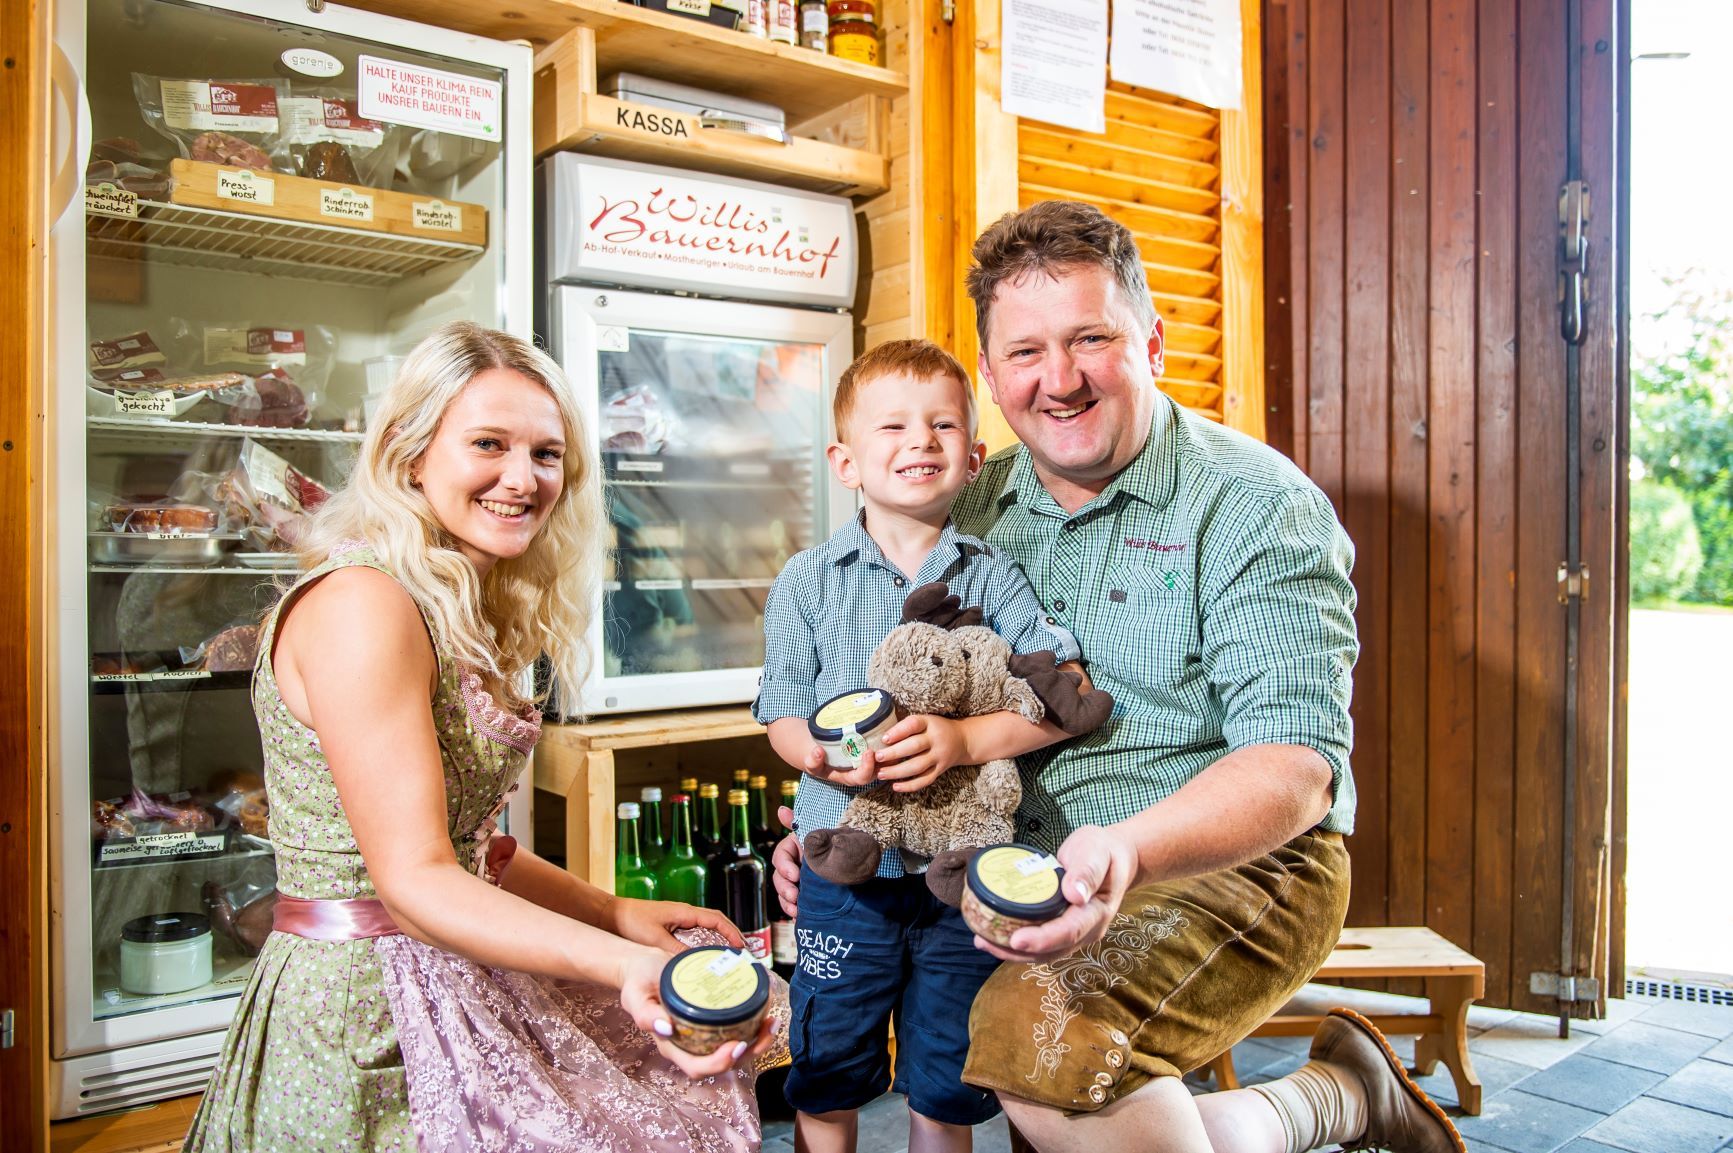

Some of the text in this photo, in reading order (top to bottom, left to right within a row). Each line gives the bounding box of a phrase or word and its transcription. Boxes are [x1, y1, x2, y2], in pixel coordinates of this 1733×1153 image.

[291, 55, 334, 71] gorenje
[366, 64, 397, 80] HALTE
[400, 71, 433, 88] UNSER
[436, 79, 466, 95] KLIMA
[391, 82, 471, 107] KAUF PRODUKTE
[378, 92, 419, 109] UNSRER
[422, 102, 462, 119] BAUERN
[616, 106, 688, 138] KASSA
[221, 178, 253, 190] Press-
[647, 187, 768, 233] Willis
[589, 195, 840, 279] Bauernhof
[583, 242, 656, 260] Ab-Hof-Verkauf
[664, 253, 720, 268] Mostheuriger
[728, 260, 755, 272] Urlaub
[773, 267, 815, 279] Bauernhof
[121, 402, 166, 412] gekocht
[797, 928, 854, 959] BEACH
[799, 949, 842, 980] VIBES
